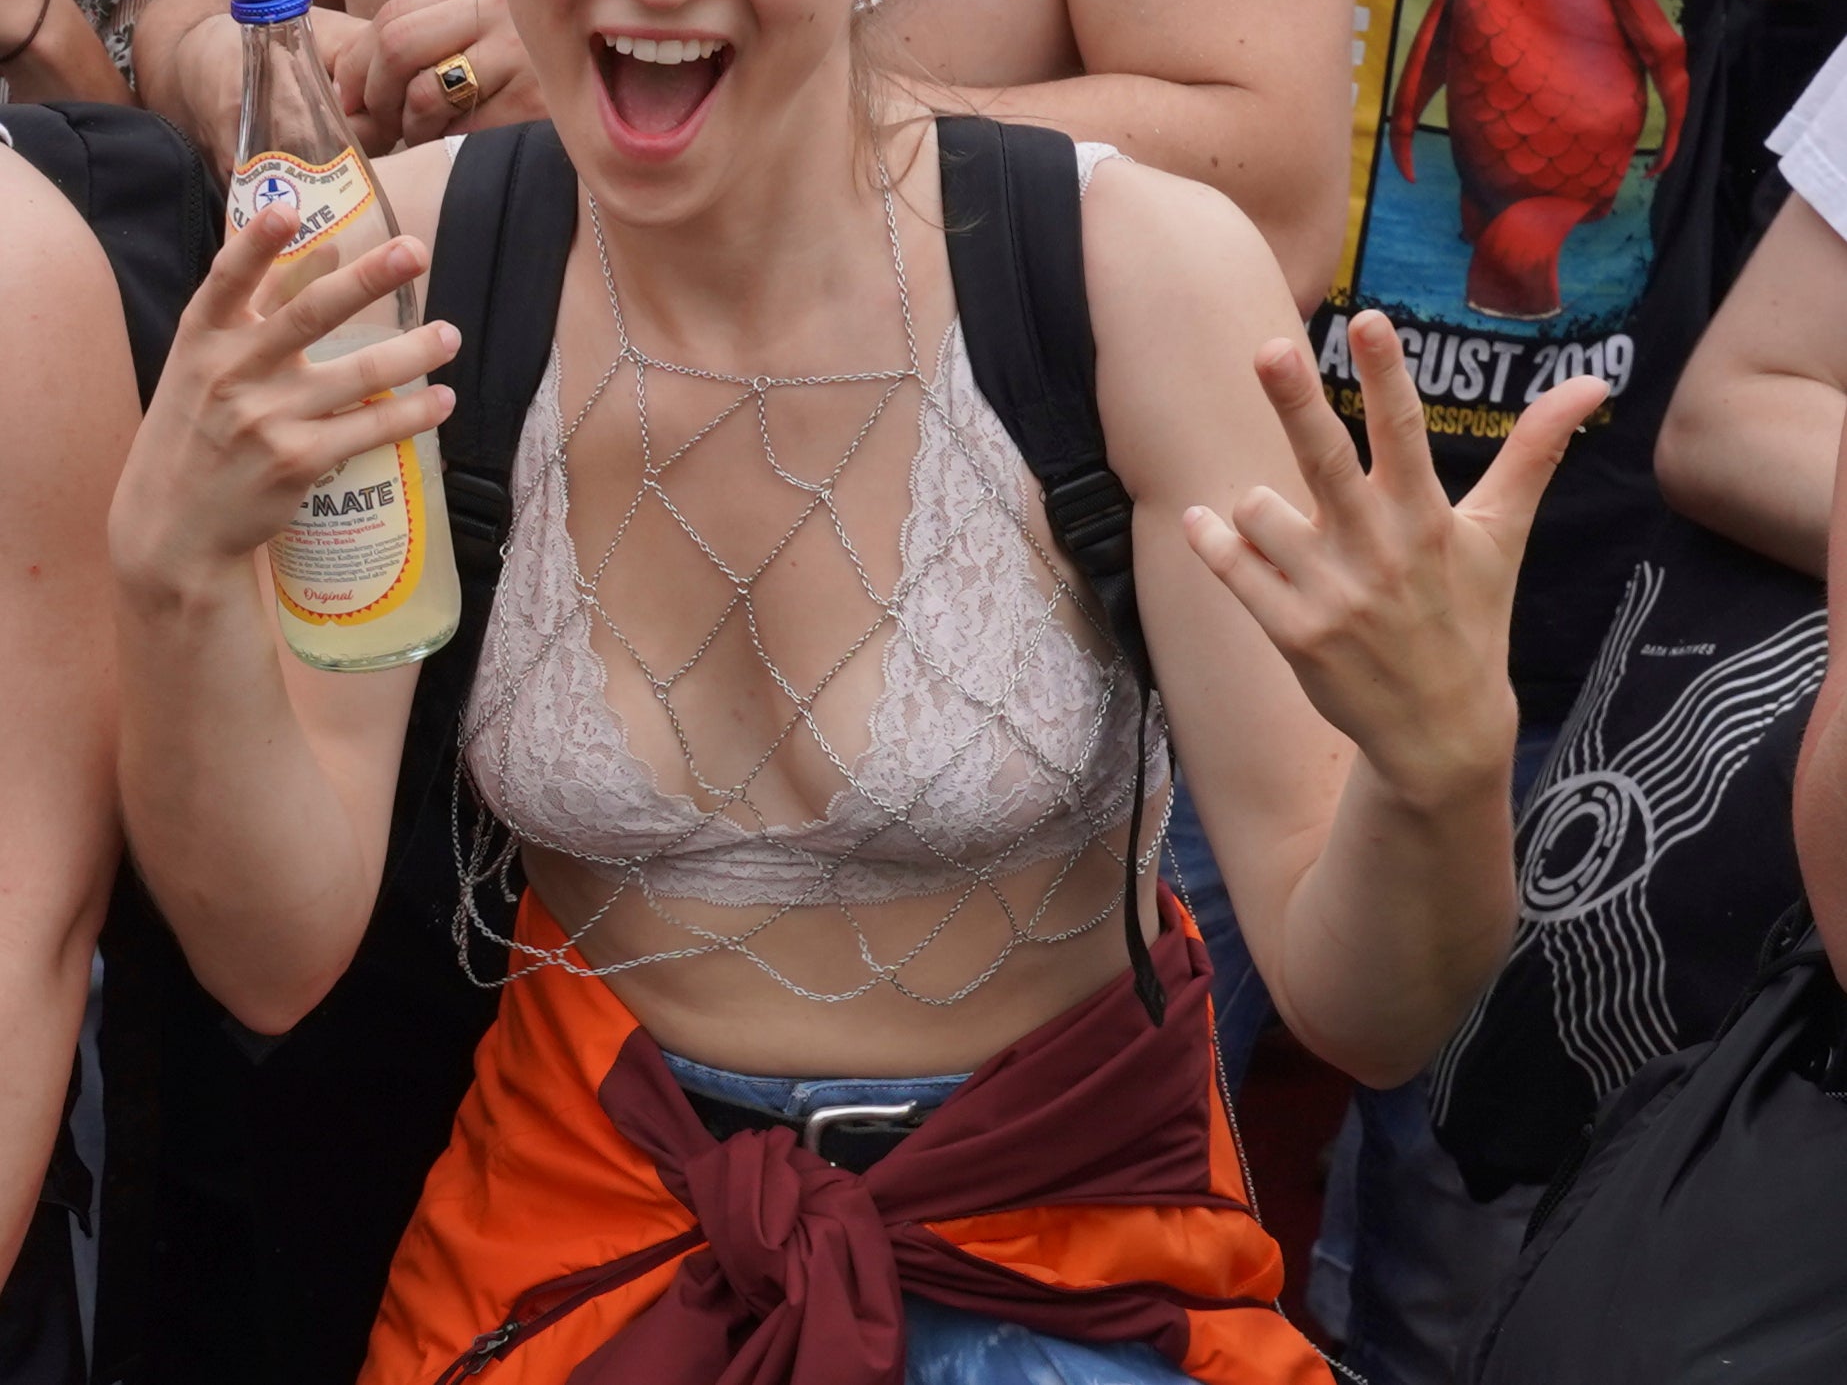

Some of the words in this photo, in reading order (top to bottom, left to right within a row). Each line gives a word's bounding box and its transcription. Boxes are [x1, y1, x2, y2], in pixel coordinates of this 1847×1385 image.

[1319, 314, 1525, 403] AGUST
[1524, 334, 1634, 403] 2019
[300, 479, 394, 517] -MATE
[304, 588, 353, 603] Original
